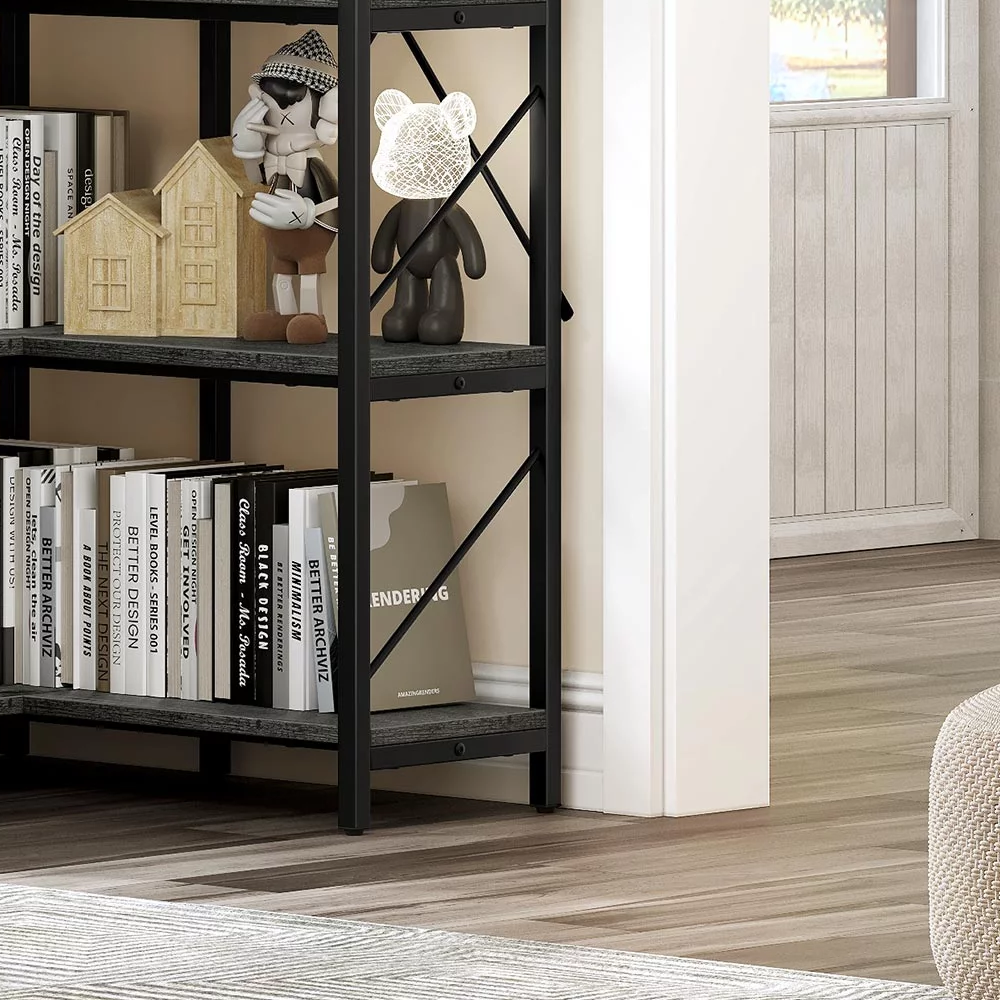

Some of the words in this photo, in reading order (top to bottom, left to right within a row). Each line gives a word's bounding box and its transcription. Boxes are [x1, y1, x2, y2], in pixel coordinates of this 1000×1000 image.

[30, 156, 41, 187] Day
[32, 194, 41, 208] of
[32, 212, 41, 238] the
[30, 243, 41, 296] design
[113, 510, 121, 572] PROTECT
[182, 525, 190, 559] GET
[239, 498, 250, 537] Class
[42, 537, 53, 591] BETTER
[98, 542, 108, 572] THE
[128, 526, 139, 583] BETTER
[239, 542, 250, 584] Room
[258, 544, 269, 590] BLACK
[98, 577, 108, 619] NEXT
[113, 575, 121, 608] OUR
[182, 566, 190, 659] INVOLVED
[291, 560, 302, 642] MINIMALISM
[308, 559, 323, 614] BETTER
[42, 594, 53, 657] ARCHVIZ
[113, 613, 121, 666] DESIGN
[128, 589, 139, 649] DESIGN
[258, 598, 269, 650] DESIGN
[98, 623, 108, 682] DESIGN
[239, 634, 250, 687] Posada
[312, 616, 329, 683] ARCHVIZ
[397, 688, 440, 698] AMAZINGRENDERS
